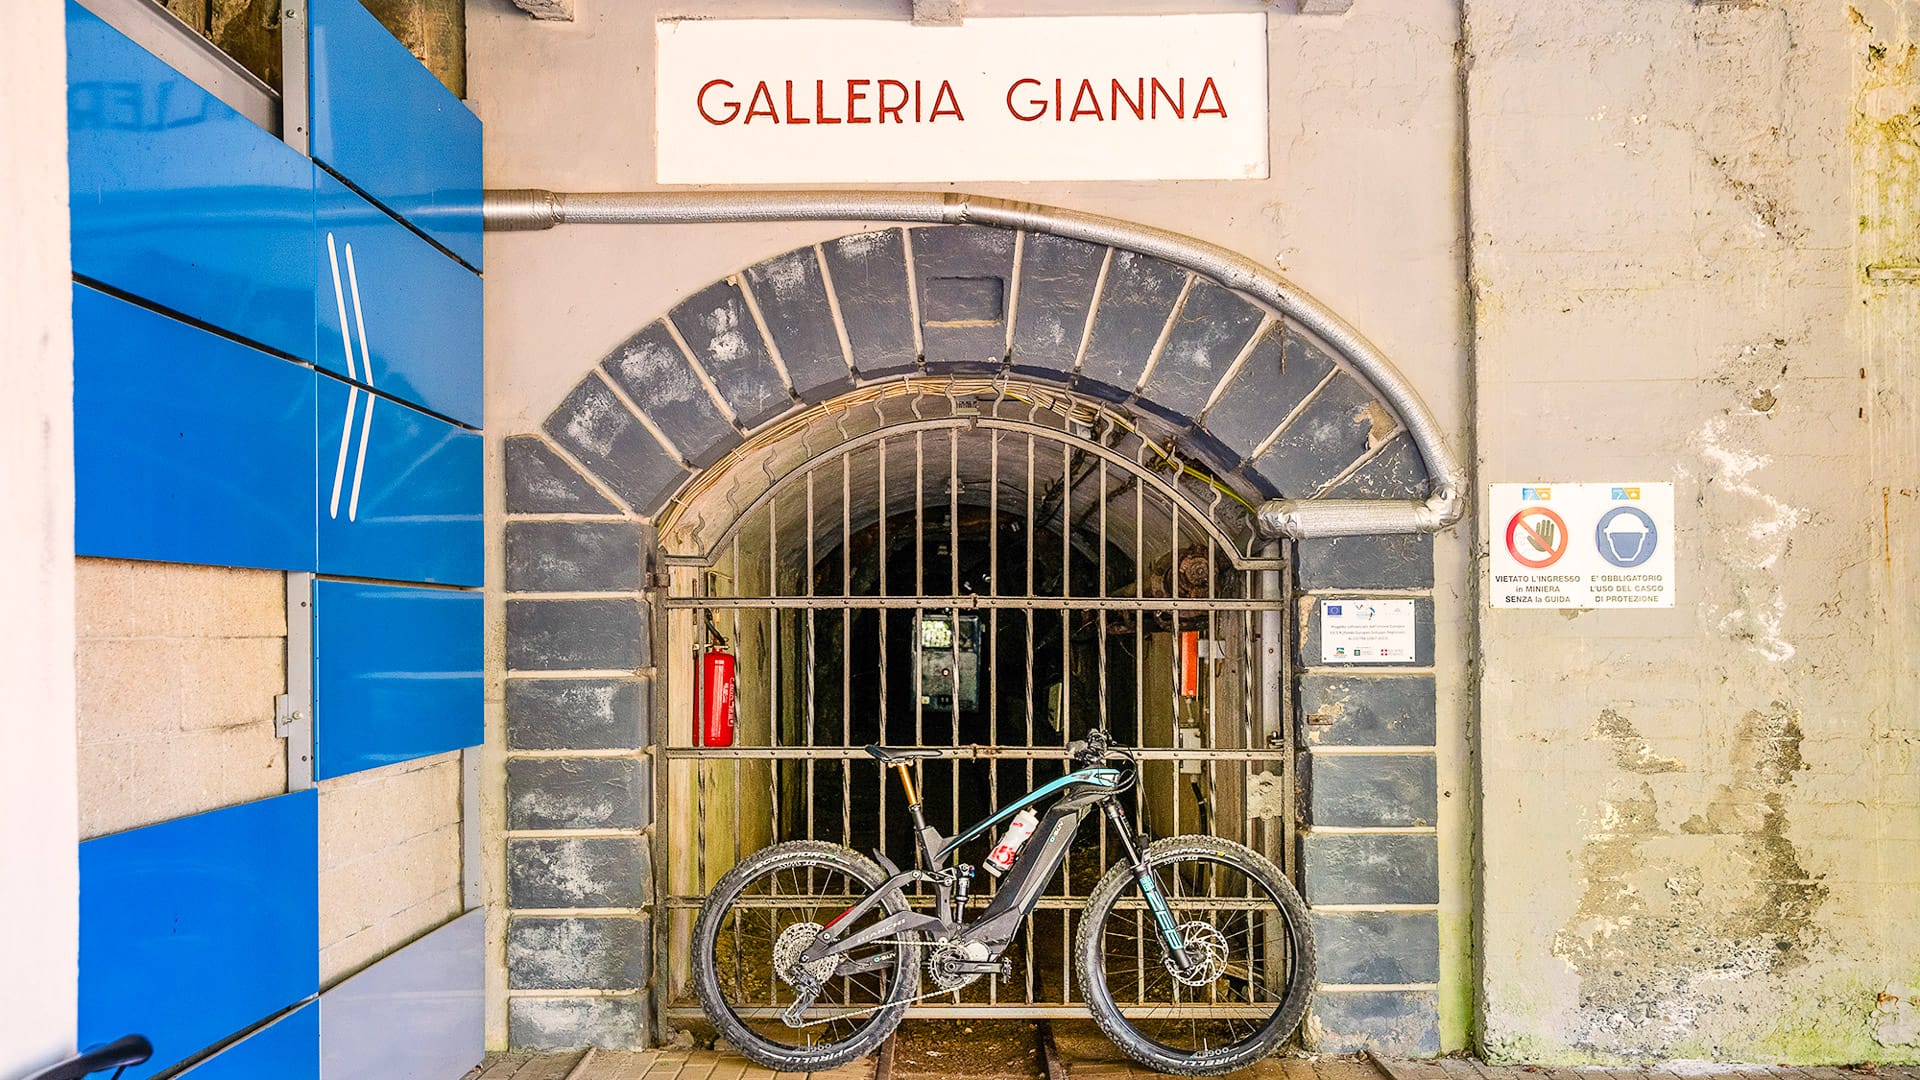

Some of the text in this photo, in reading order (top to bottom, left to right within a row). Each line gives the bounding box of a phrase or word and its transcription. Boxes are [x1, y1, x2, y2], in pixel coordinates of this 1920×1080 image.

[696, 76, 1228, 126] GALLERIA GIANNA
[1495, 575, 1581, 583] VIETATO L'INGRESSO
[1600, 574, 1662, 582] OBBLIGATORIO
[1515, 585, 1560, 593] in MINIERA
[1505, 595, 1571, 603] SENZA la GUIDA
[1594, 595, 1659, 603] DI PROTEZIONE
[1144, 890, 1184, 950] ZEB
[785, 1049, 844, 1063] PIRELLI
[1181, 1053, 1239, 1067] PIRELLI
